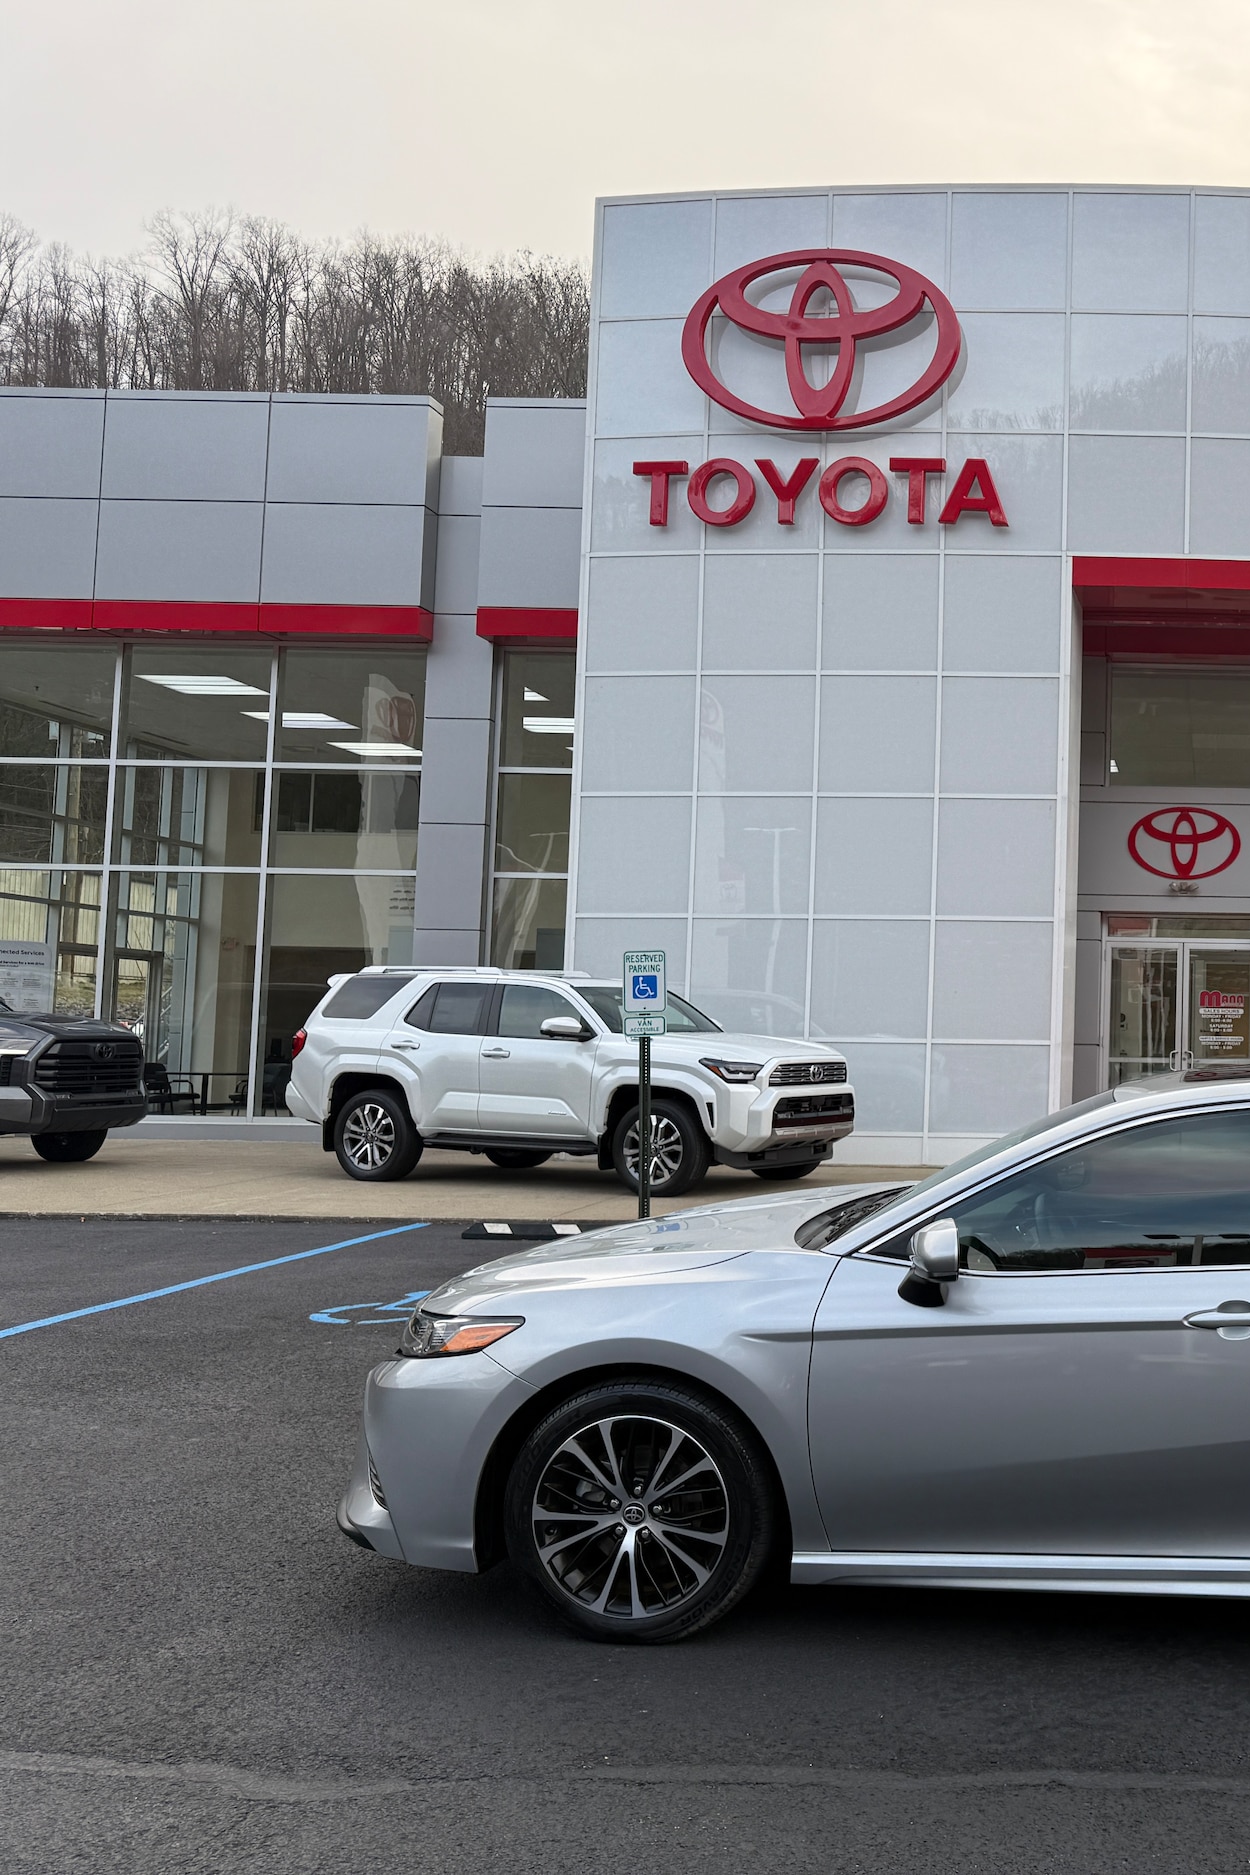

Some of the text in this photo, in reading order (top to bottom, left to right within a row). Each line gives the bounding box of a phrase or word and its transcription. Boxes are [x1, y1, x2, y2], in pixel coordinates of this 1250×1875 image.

[632, 456, 1009, 528] TOYOTA
[625, 954, 664, 963] RESERVED
[628, 964, 661, 973] PARKING
